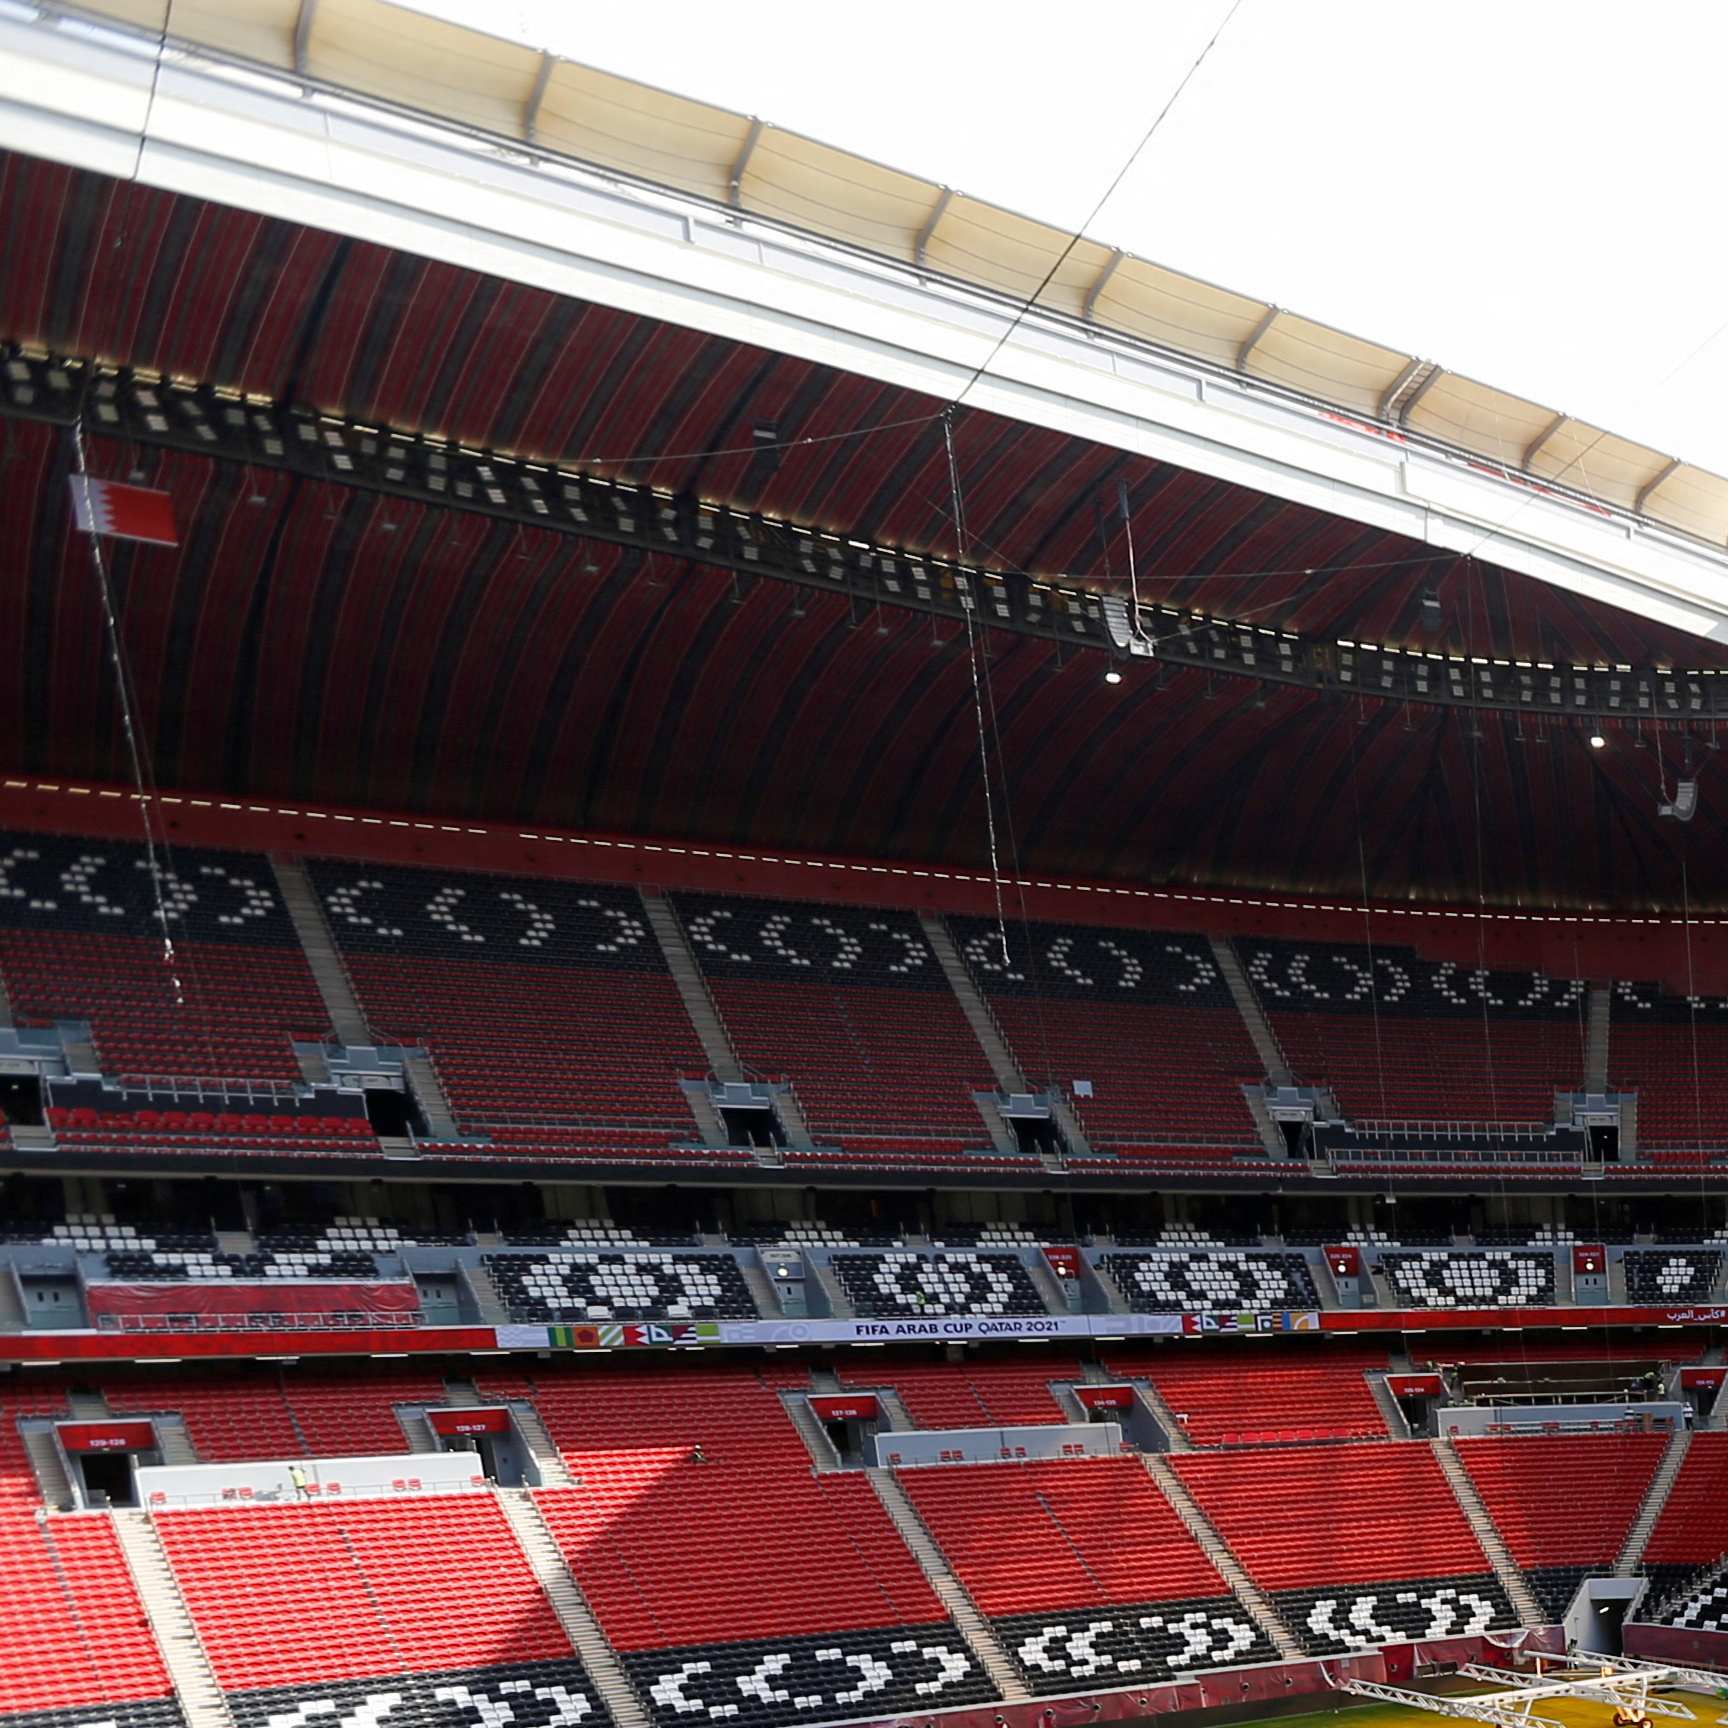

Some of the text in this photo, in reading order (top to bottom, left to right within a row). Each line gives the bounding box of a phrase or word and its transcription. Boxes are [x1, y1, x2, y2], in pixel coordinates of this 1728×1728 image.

[855, 1324, 890, 1336] FIFA
[895, 1323, 939, 1335] ARAB
[943, 1322, 973, 1334] CUP
[978, 1321, 1022, 1335] QATAR
